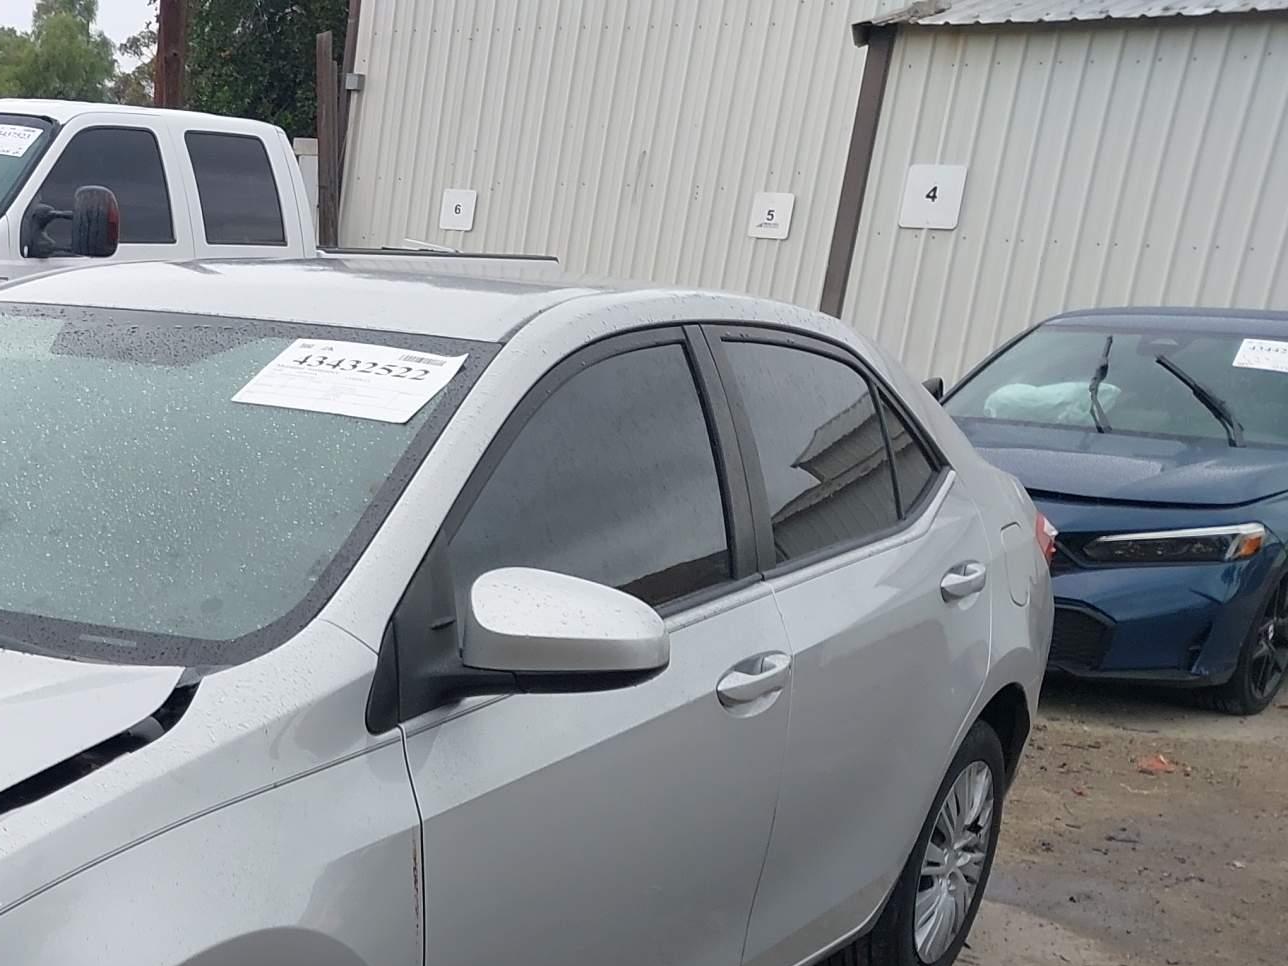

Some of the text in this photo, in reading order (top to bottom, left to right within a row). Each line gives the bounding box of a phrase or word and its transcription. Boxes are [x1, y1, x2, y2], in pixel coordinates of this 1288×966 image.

[925, 186, 938, 202] 4
[454, 204, 462, 215] 6
[766, 209, 775, 221] 5
[292, 354, 431, 381] 43432522
